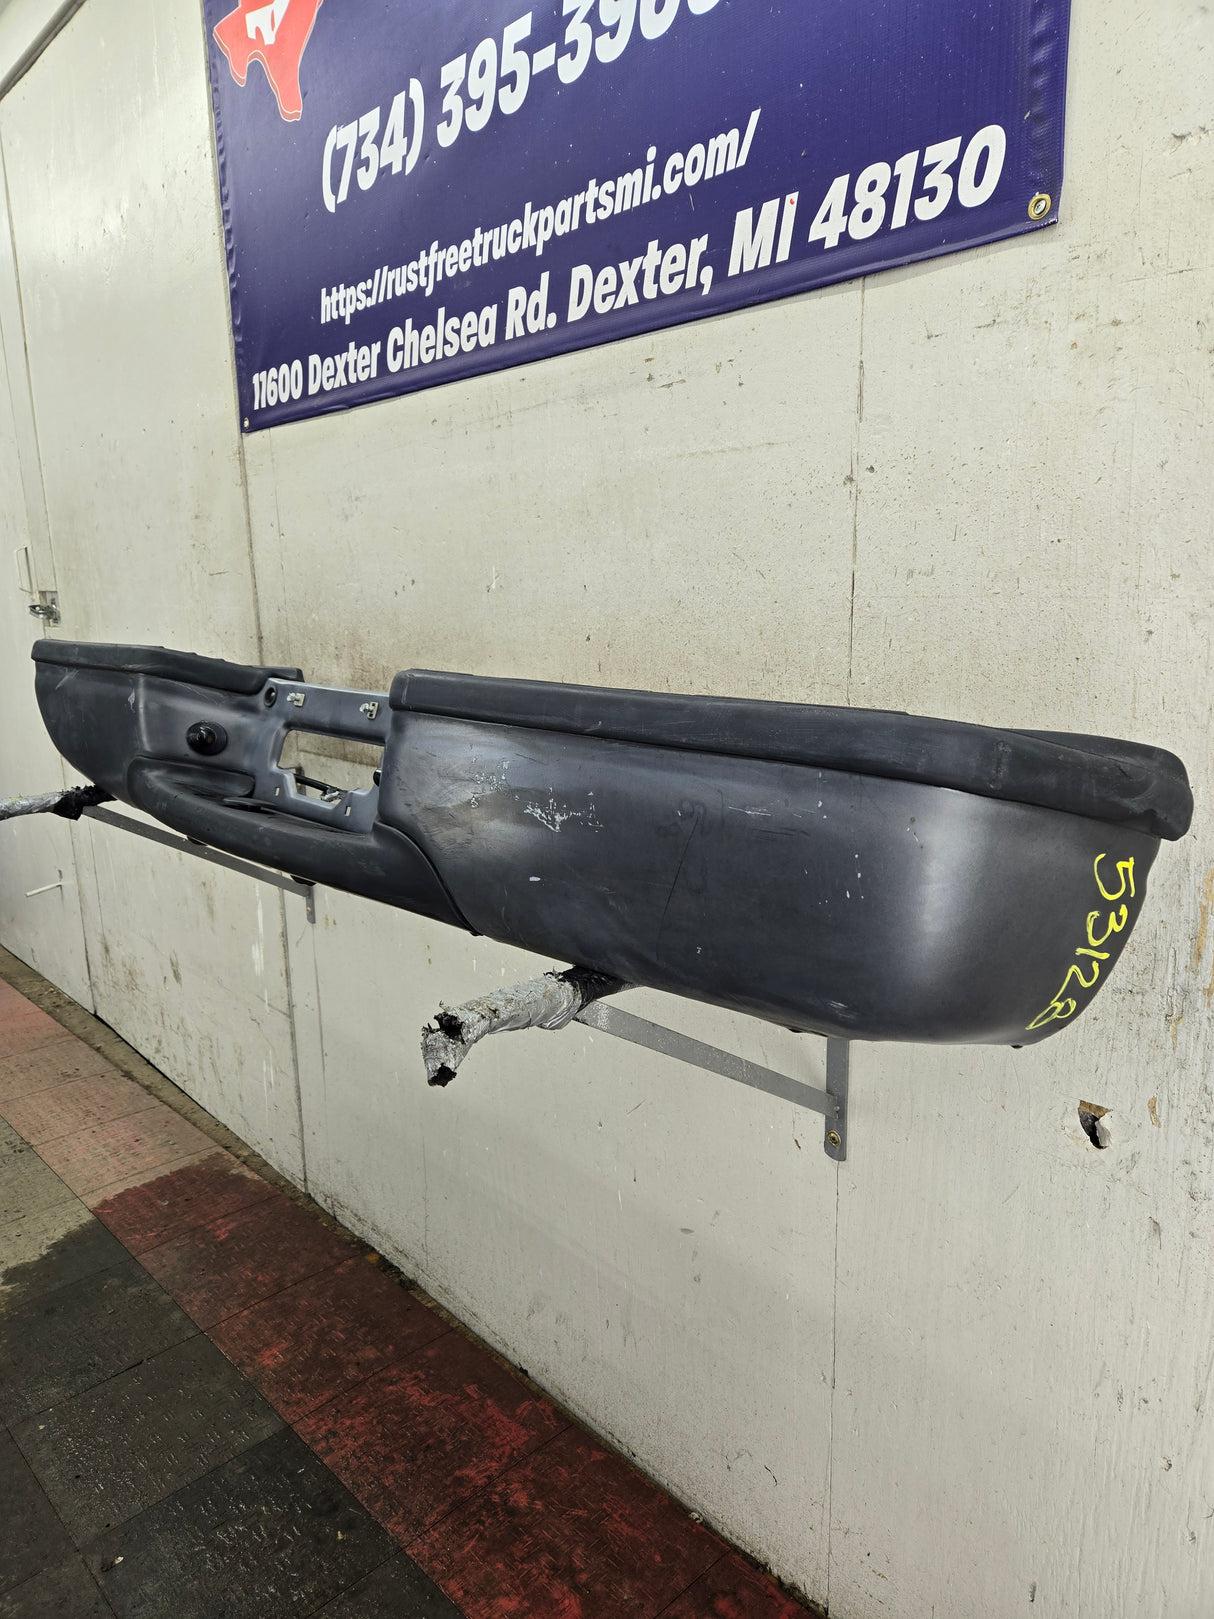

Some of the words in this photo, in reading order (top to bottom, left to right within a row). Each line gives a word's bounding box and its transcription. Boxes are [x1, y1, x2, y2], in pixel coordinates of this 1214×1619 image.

[322, 78, 425, 213] (734)
[437, 0, 720, 149] 395-39
[252, 359, 302, 411] 11600
[307, 341, 381, 396] Dexter
[386, 304, 498, 373] Chelsea
[505, 271, 557, 341] Rd.
[566, 233, 714, 323] Dexter,
[727, 190, 800, 278] MI
[807, 124, 1007, 250] 48130
[320, 108, 762, 325] https://rustfreetruckpartsmi.com/
[1025, 853, 1136, 1030] 53128
